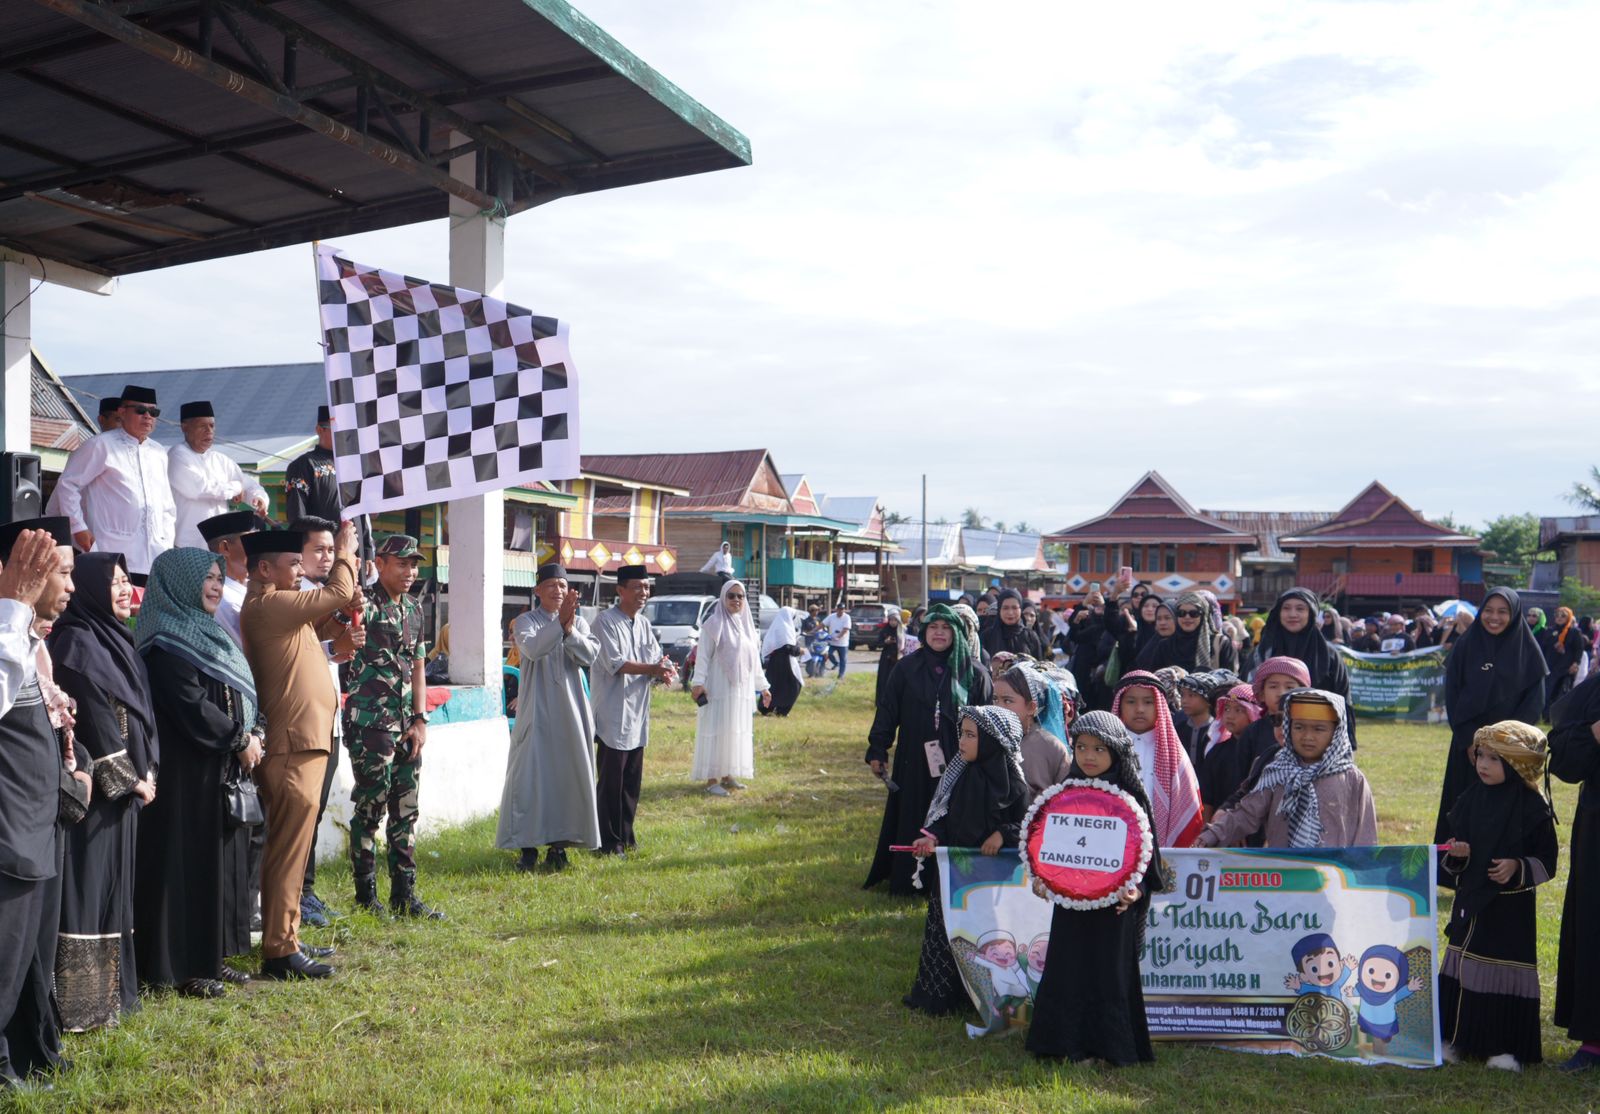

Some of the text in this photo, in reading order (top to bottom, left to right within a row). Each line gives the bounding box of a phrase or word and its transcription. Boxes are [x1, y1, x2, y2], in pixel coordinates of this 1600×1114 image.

[1051, 815, 1117, 830] TK NEGRI
[1076, 836, 1087, 848] 4
[1040, 851, 1120, 868] TANASITOLO
[1185, 872, 1216, 902] 01
[1163, 901, 1248, 930] Tahun
[1250, 899, 1322, 935] Baru
[1140, 972, 1261, 989] uharram 1448 H
